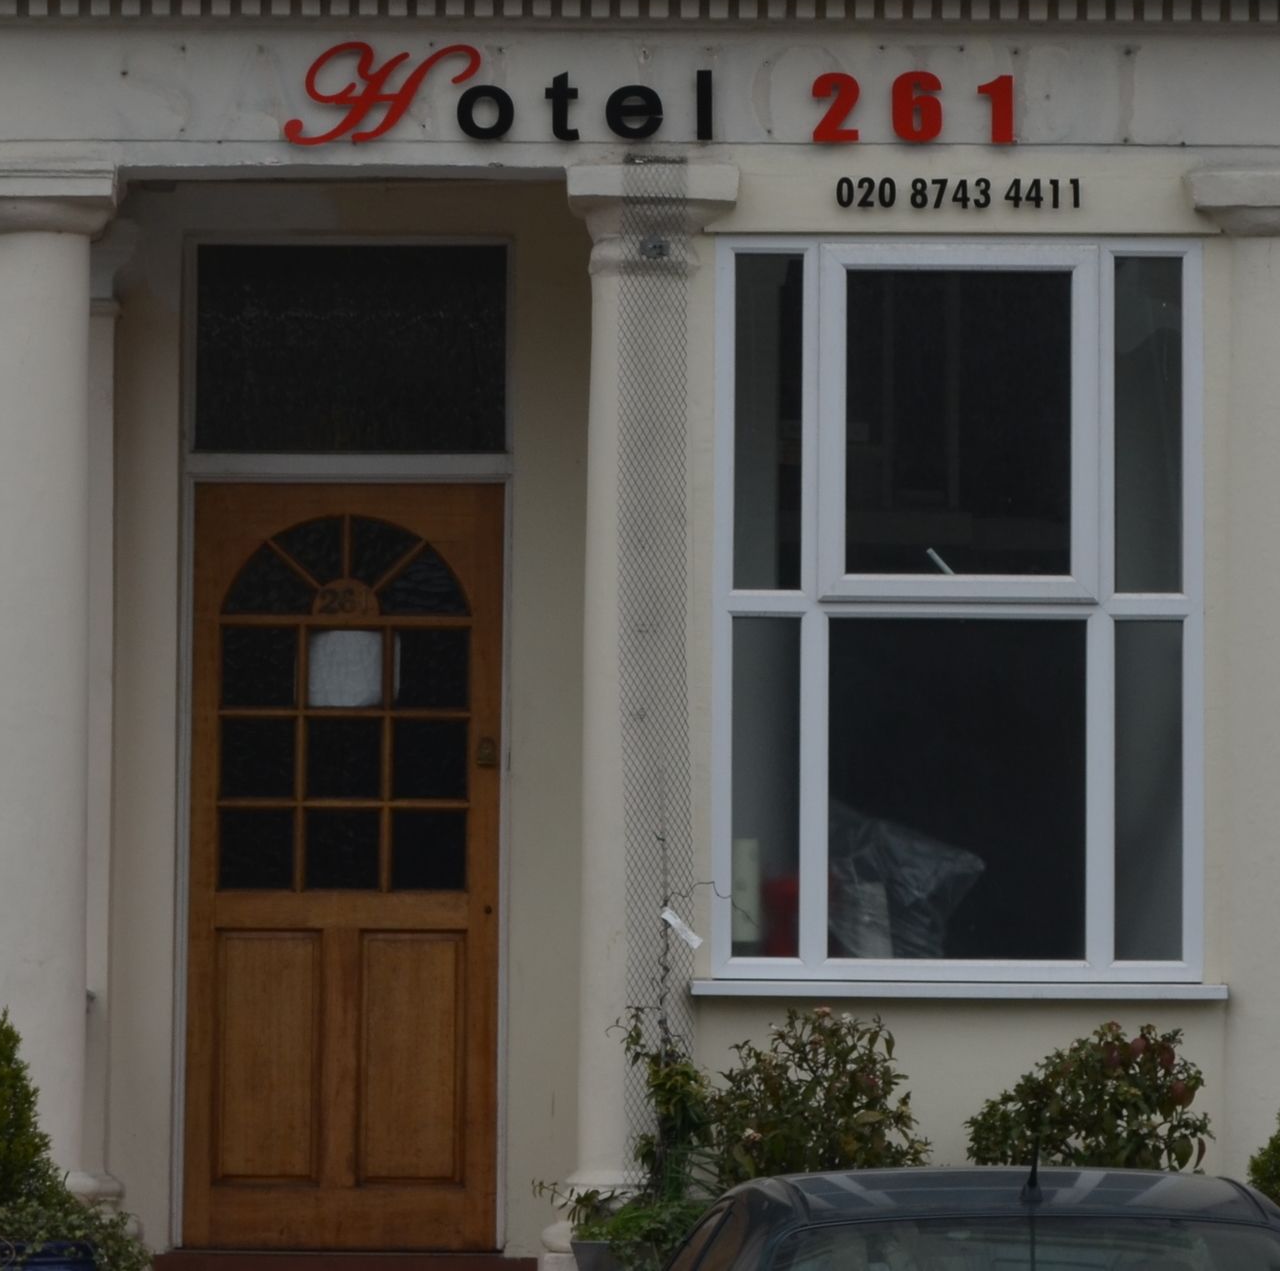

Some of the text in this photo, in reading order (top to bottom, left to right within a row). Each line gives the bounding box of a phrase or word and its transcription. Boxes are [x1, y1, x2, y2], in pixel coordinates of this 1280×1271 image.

[285, 41, 1014, 146] Hotel 261
[836, 177, 1080, 209] 020 8743 4411
[319, 589, 370, 615] 261
